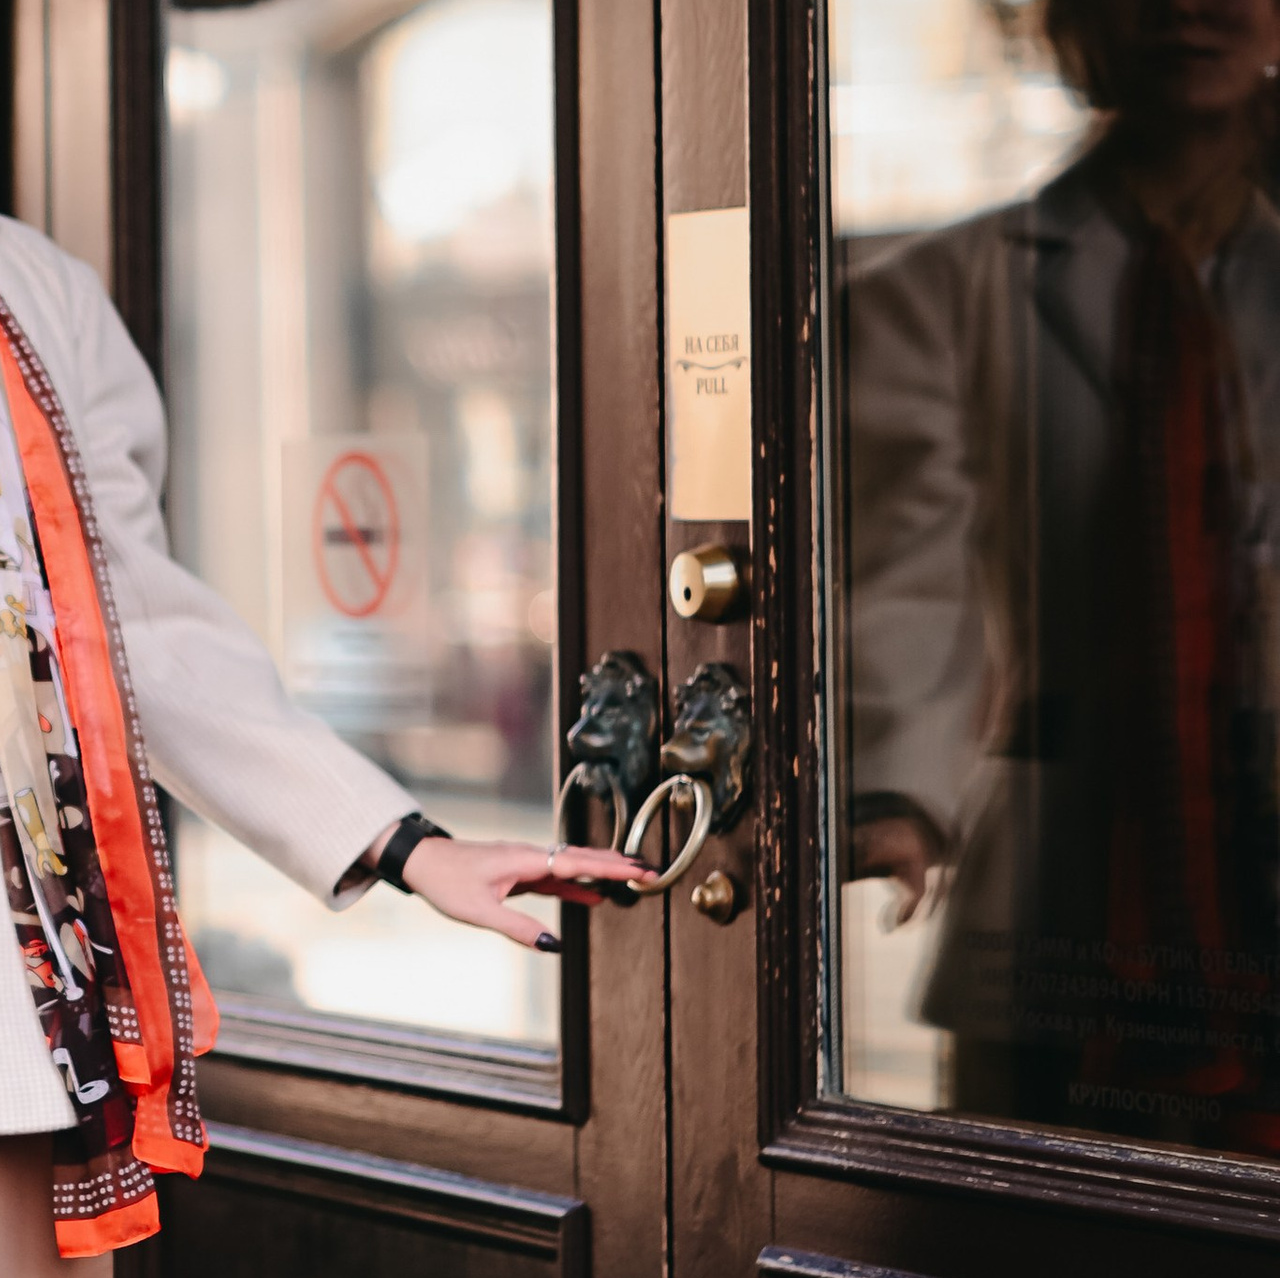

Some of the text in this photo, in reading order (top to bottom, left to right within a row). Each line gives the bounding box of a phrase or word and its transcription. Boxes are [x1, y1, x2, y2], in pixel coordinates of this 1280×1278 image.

[685, 333, 739, 354] НА СЕБЯ
[696, 377, 728, 395] PULL
[1105, 1013, 1201, 1046] Кузнецкий
[1205, 1030, 1249, 1051] мост
[1068, 1082, 1221, 1122] КРУГЛОСУТОЧНО
